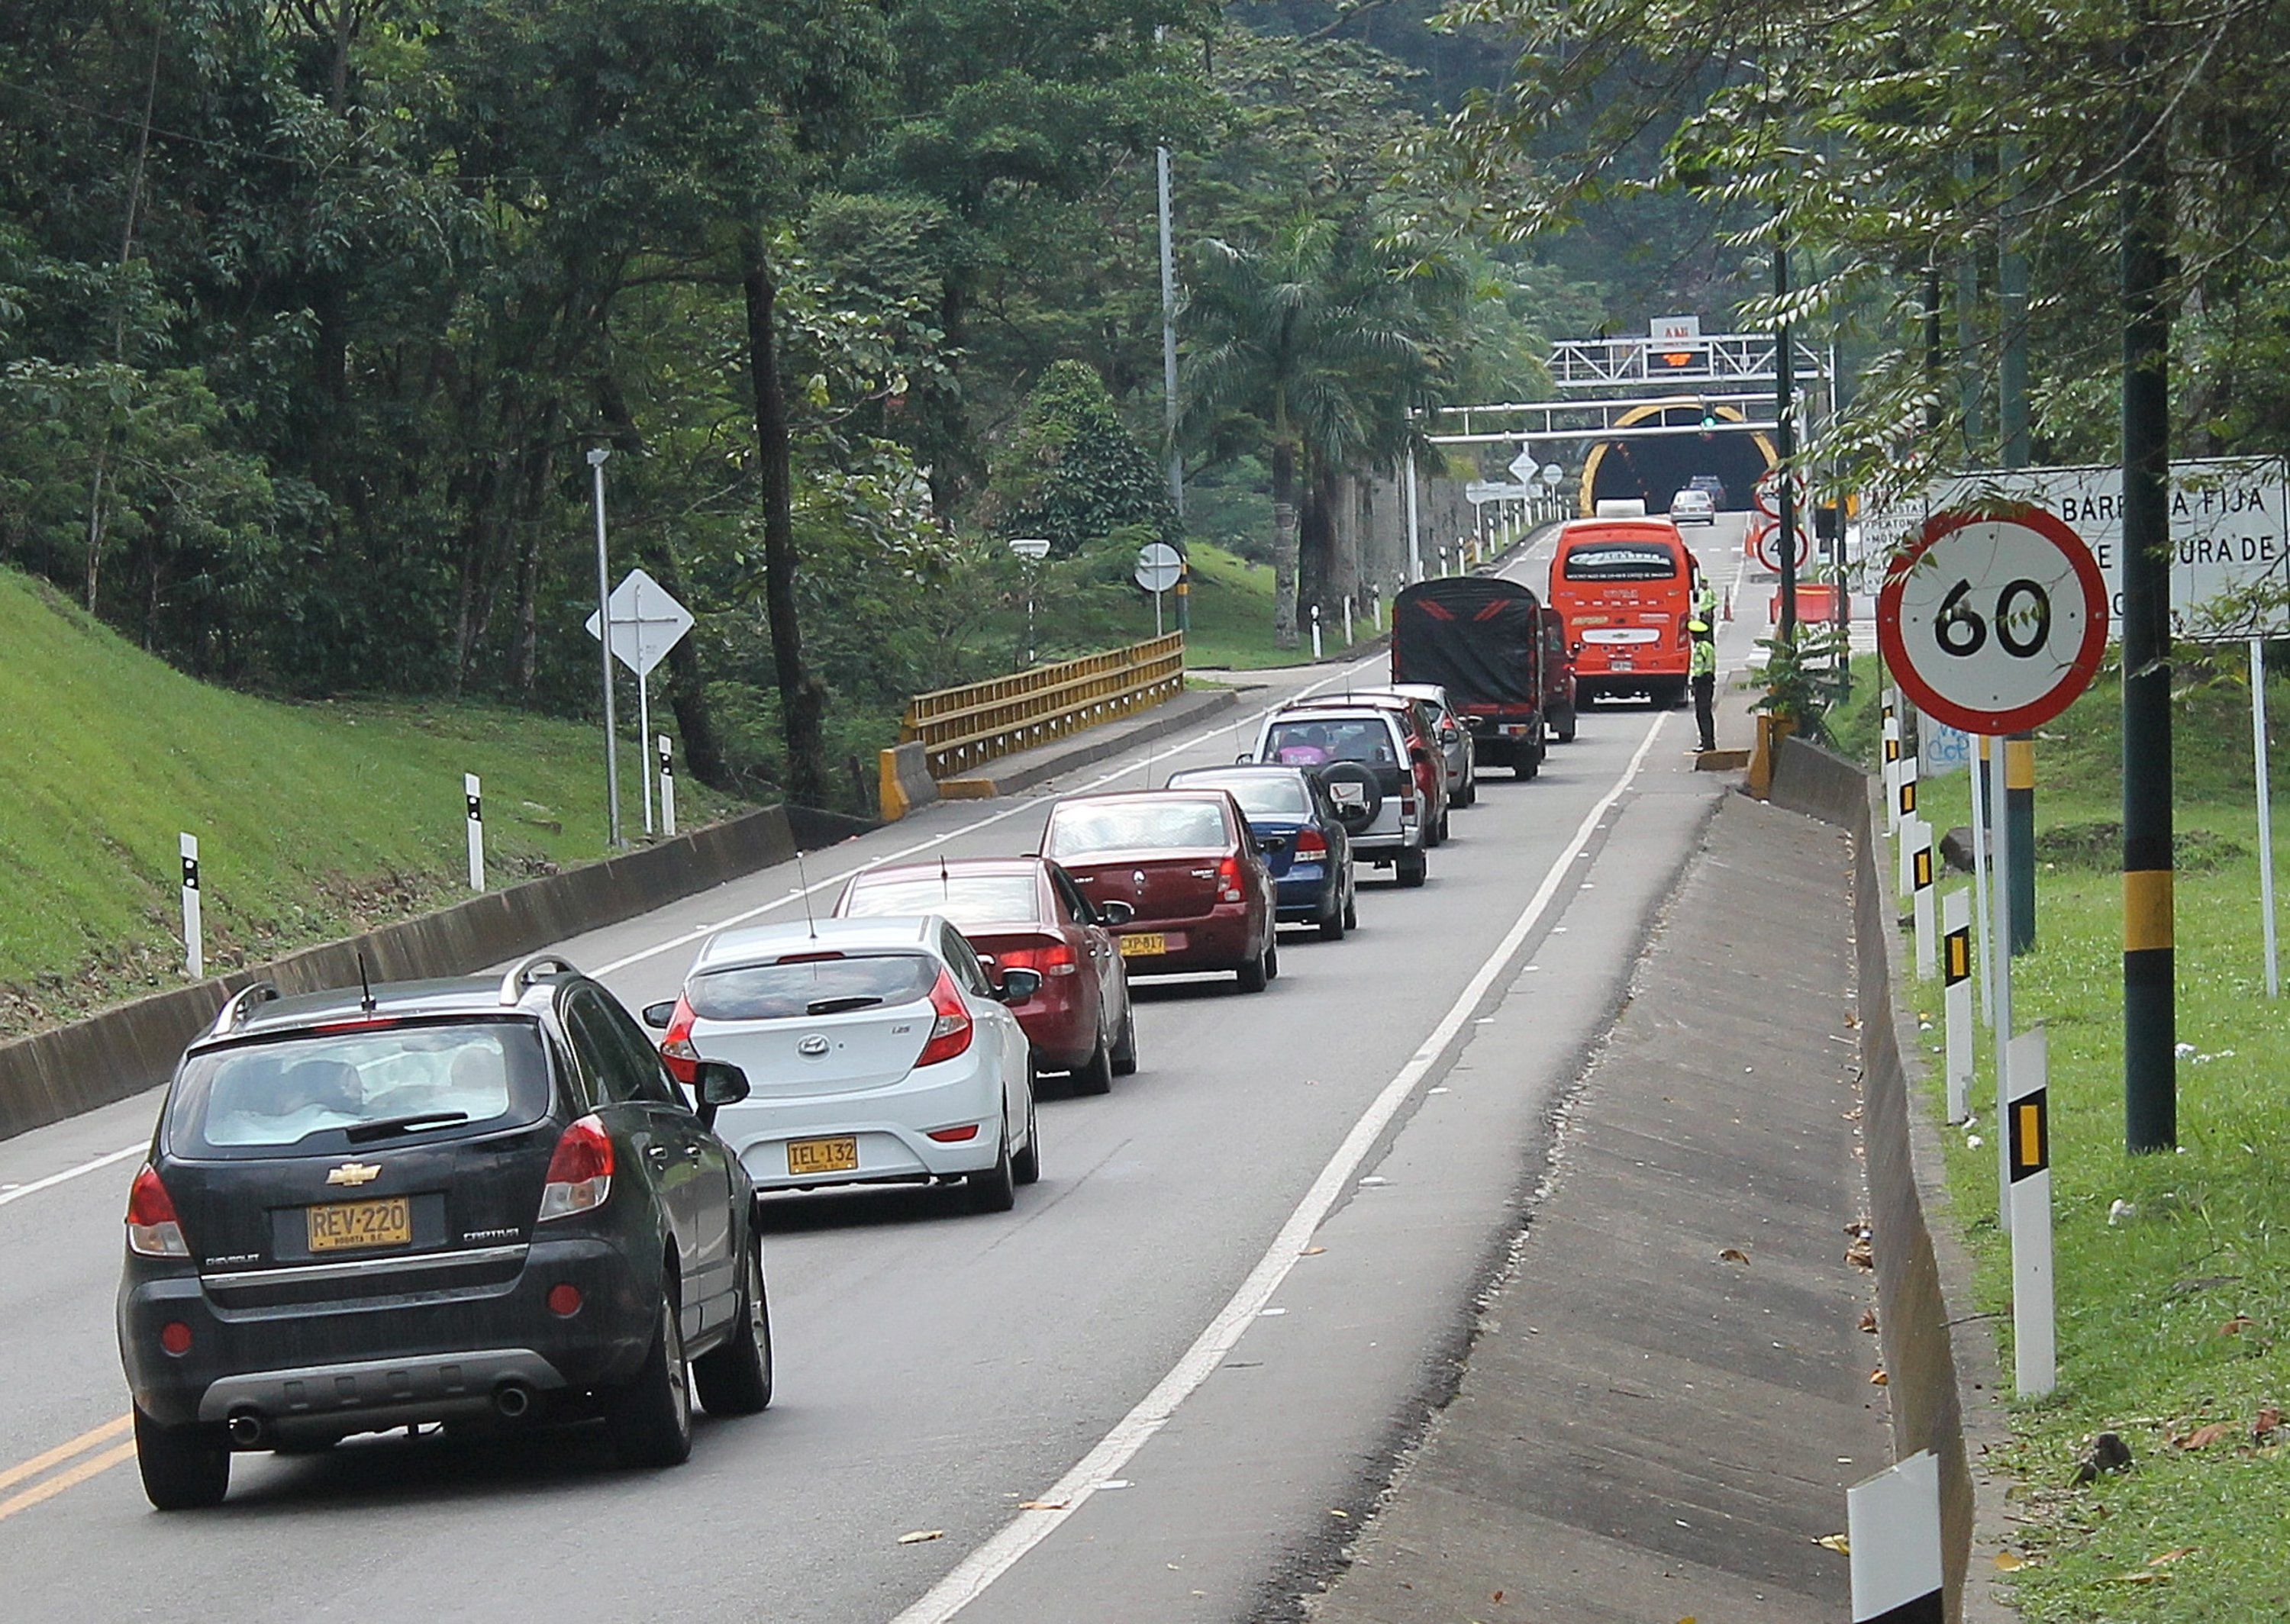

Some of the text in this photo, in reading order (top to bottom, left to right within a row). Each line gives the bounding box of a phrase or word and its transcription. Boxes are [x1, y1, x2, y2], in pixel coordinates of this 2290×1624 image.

[2063, 488, 2265, 521] BARA FIJA
[2179, 536, 2233, 565] URA
[2241, 536, 2274, 562] DE
[1935, 578, 2051, 658] 60
